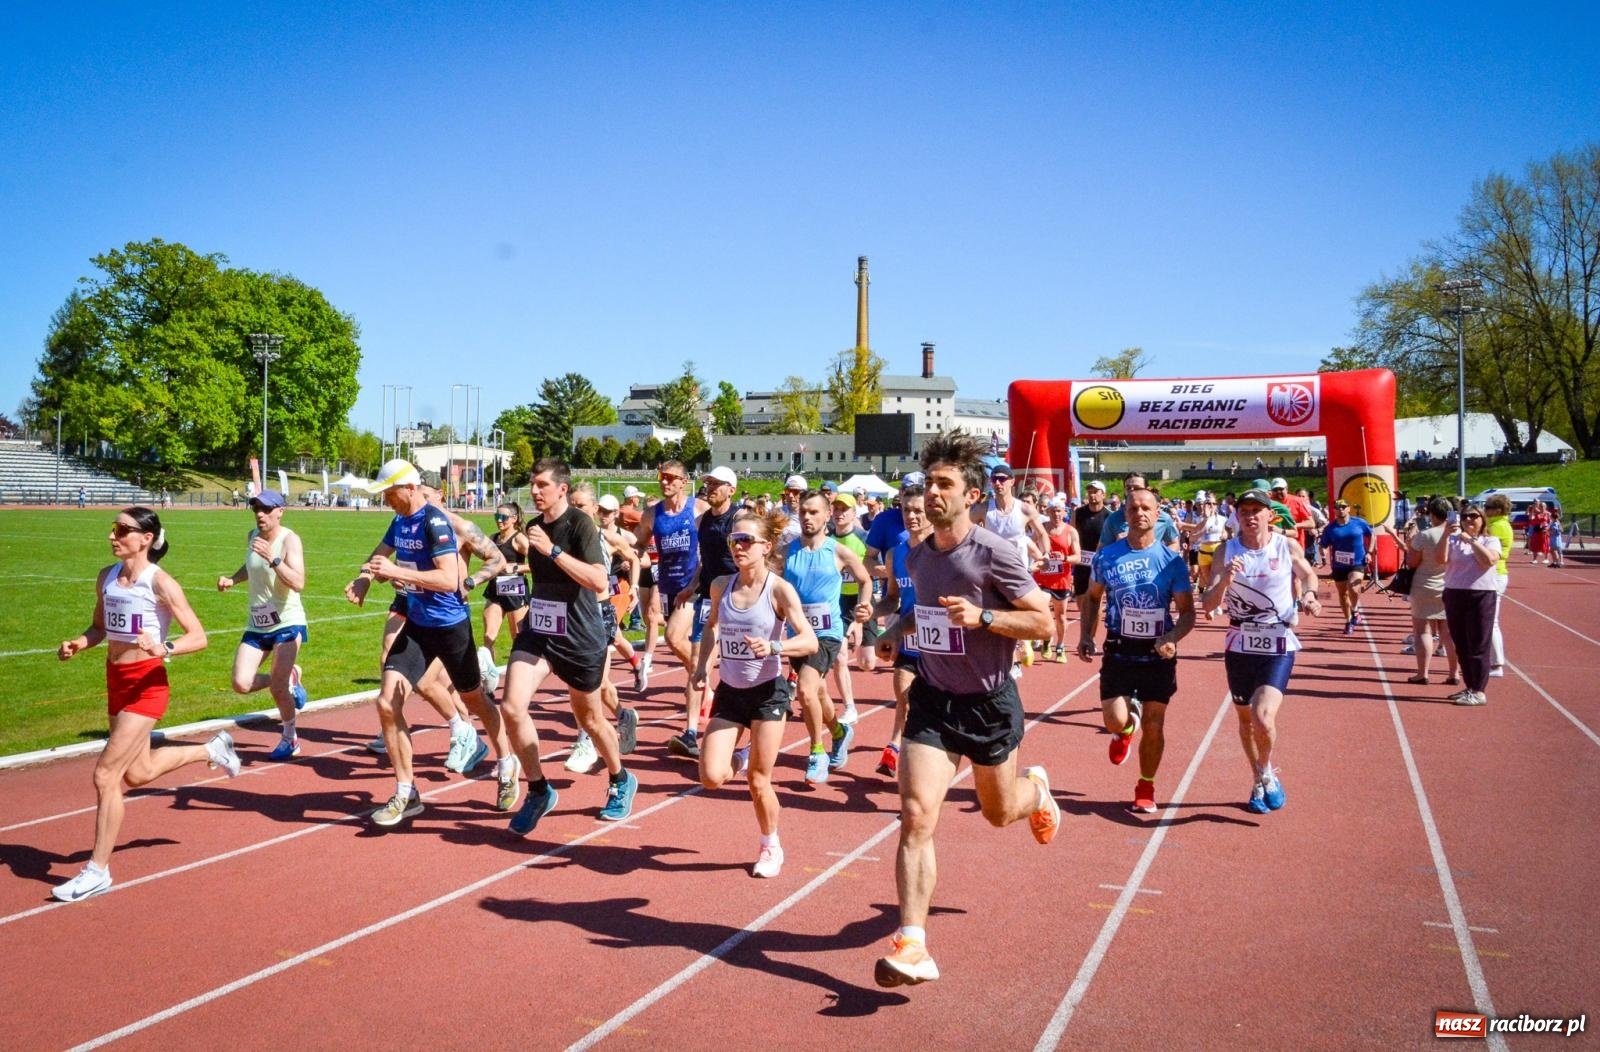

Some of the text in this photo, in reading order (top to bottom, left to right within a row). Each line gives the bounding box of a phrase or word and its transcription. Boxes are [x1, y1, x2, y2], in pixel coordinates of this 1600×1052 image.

[1170, 384, 1215, 395] BIEG
[1138, 399, 1248, 412] BEZ GRANIC
[1147, 415, 1239, 430] RACIBÓRZ
[1106, 557, 1150, 580] MORSY
[1109, 569, 1154, 586] RACIBÓRZ
[501, 584, 515, 593] 214
[107, 611, 127, 628] 135
[254, 614, 270, 625] 102
[534, 613, 553, 628] 175
[1131, 621, 1149, 633] 131
[921, 626, 942, 645] 112
[1247, 636, 1272, 650] 128
[725, 640, 750, 656] 182
